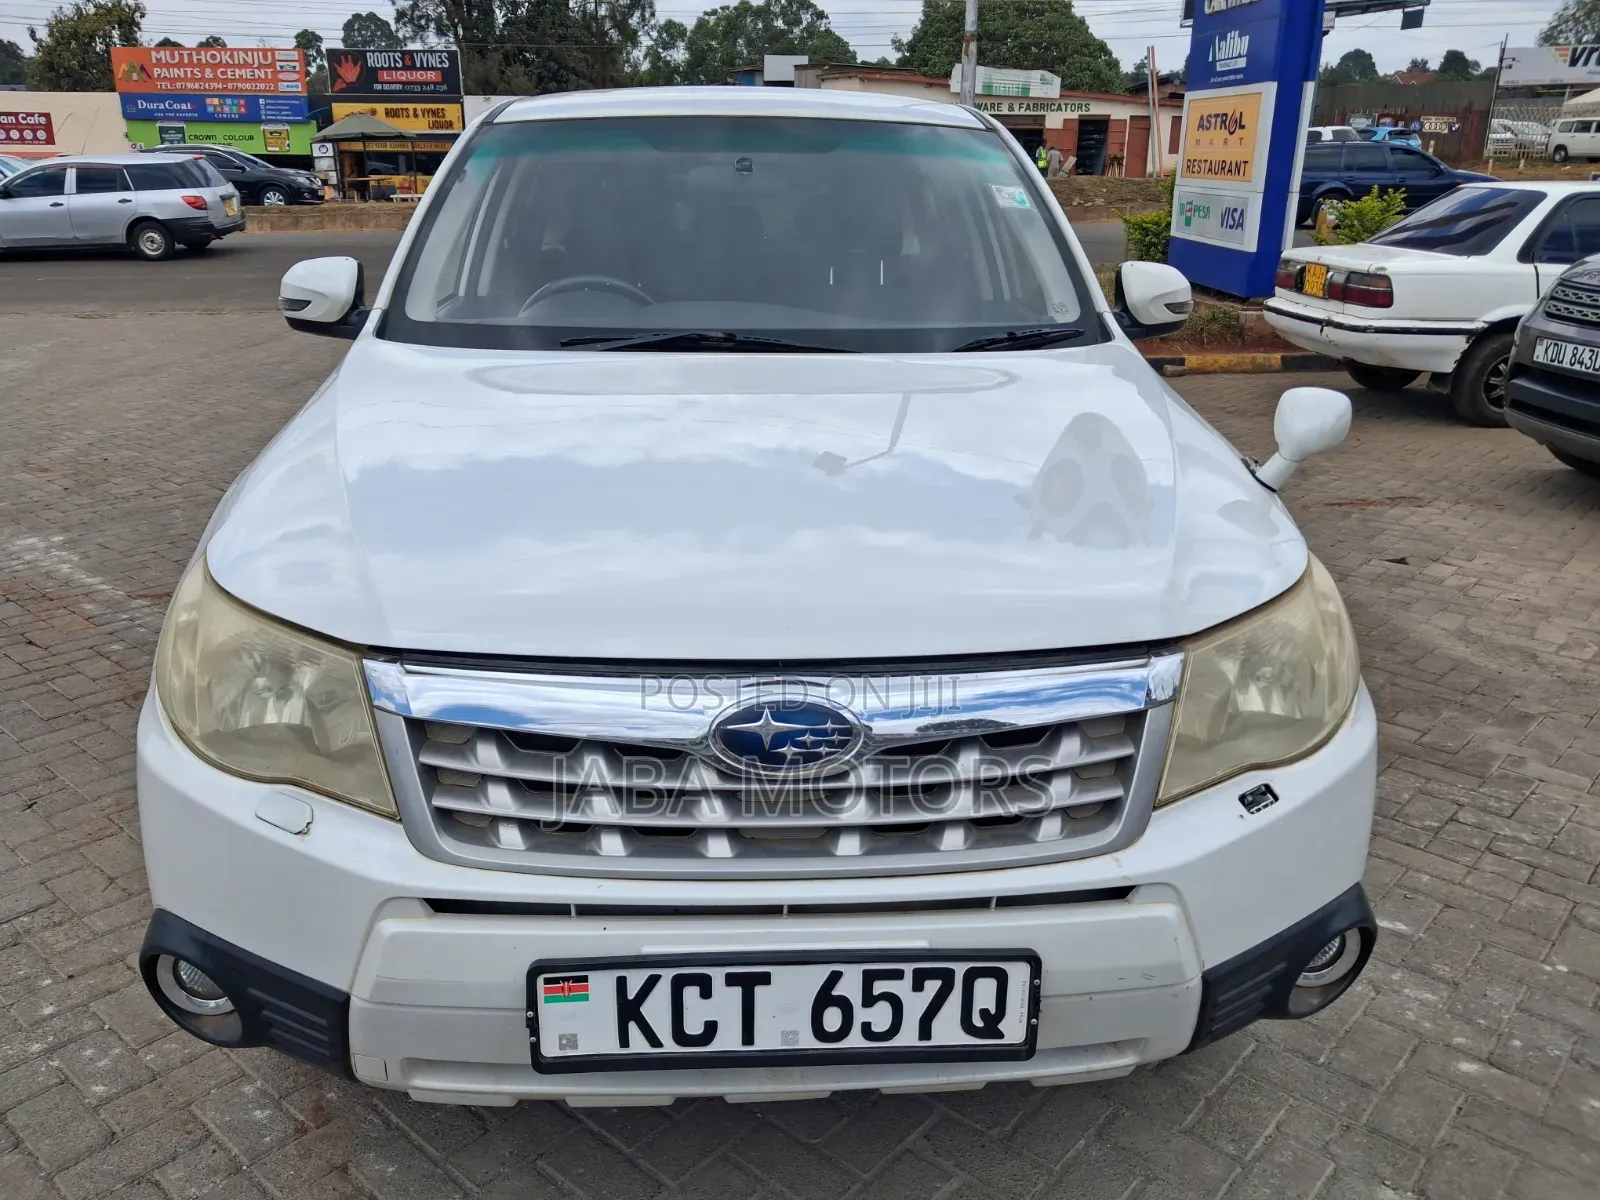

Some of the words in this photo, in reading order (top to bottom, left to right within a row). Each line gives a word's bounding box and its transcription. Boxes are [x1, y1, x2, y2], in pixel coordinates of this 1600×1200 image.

[151, 51, 272, 67] MUTHOKINJU
[366, 52, 403, 68] ROOTS
[404, 54, 412, 66] &
[413, 52, 449, 68] VYNES
[153, 67, 201, 79] PAINTS
[205, 67, 214, 79] &
[217, 68, 274, 79] CEMENT
[383, 71, 436, 80] LIQUOR
[422, 84, 434, 92] 248
[435, 84, 448, 92] 236
[138, 100, 192, 110] DuraCoat
[1008, 102, 1015, 112] &
[1018, 102, 1091, 112] FABRICATORS
[18, 113, 47, 124] Cafe
[384, 108, 410, 119] ROOTS
[412, 107, 419, 118] &
[421, 108, 446, 119] VYNES
[428, 120, 454, 130] LIQUOR
[1197, 110, 1246, 135] ASTROL
[1195, 138, 1243, 146] MART
[1186, 159, 1249, 177] RESTAURANT
[1221, 206, 1245, 231] VISA
[1543, 340, 1568, 365] KDU
[616, 971, 772, 1048] KCT
[811, 966, 1009, 1043] 657Q
